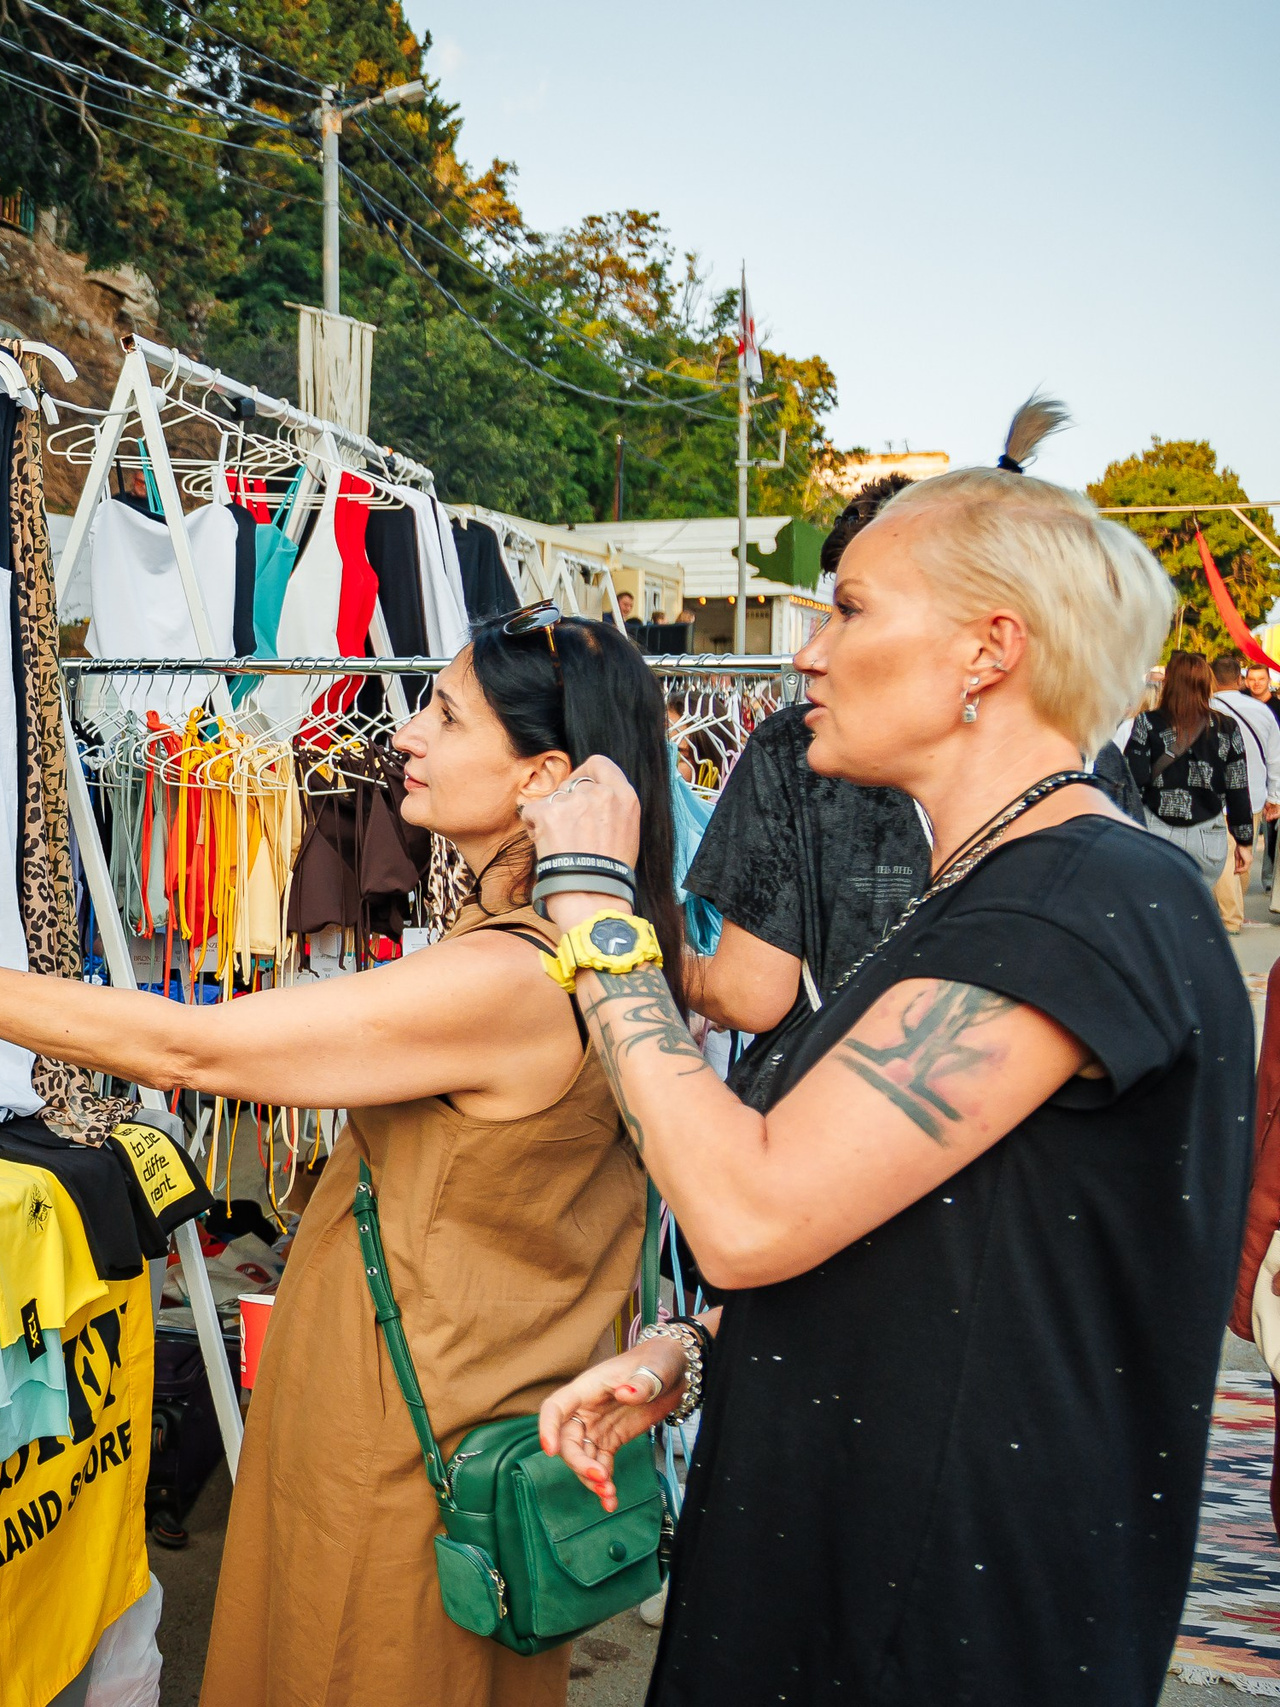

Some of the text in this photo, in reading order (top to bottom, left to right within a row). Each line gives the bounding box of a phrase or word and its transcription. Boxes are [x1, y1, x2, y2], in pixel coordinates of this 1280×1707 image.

[552, 857, 575, 868] YOUR
[576, 856, 596, 867] BODY
[130, 1133, 160, 1158] to be
[143, 1153, 170, 1182] diffe
[150, 1173, 178, 1204] rent
[27, 1311, 41, 1348] XCL
[67, 1418, 132, 1512] SORE
